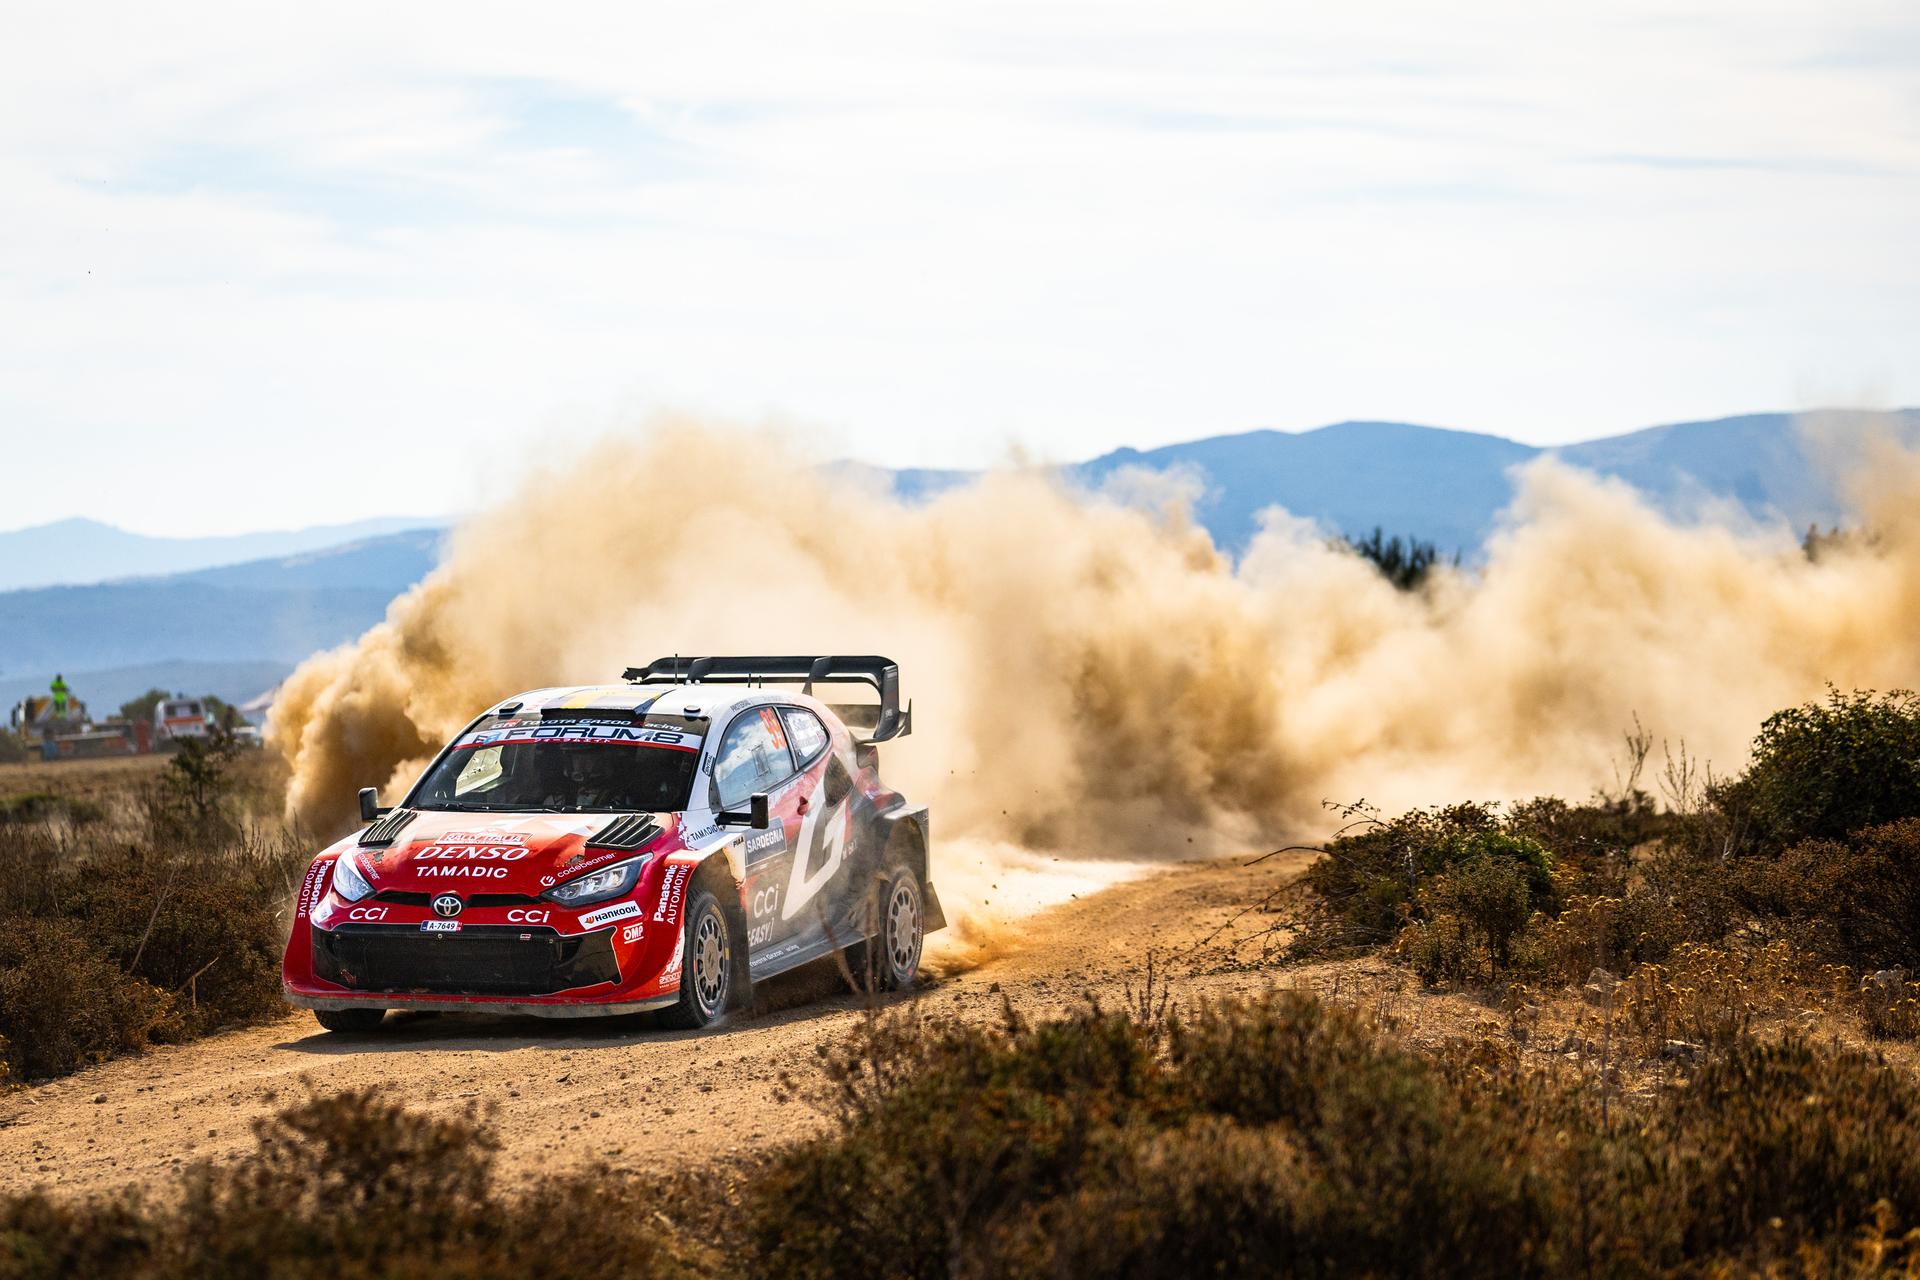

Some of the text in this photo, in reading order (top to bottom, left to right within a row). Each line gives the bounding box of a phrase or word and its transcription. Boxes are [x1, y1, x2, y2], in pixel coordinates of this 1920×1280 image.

[522, 719, 577, 727] TOYOTA
[579, 718, 632, 727] GAZOO
[505, 727, 684, 744] FORUM8
[746, 828, 784, 854] SARDEGNA
[413, 846, 530, 860] DENSO
[416, 866, 508, 878] TAMADIC
[557, 852, 616, 878] codebeamer
[298, 859, 321, 919] AUTOMOTIVE
[308, 859, 335, 916] Panasonic
[653, 864, 679, 922] Panasonic
[666, 864, 691, 925] AUTOMOTIVE
[429, 922, 456, 930] A-7649
[623, 926, 644, 941] OMP
